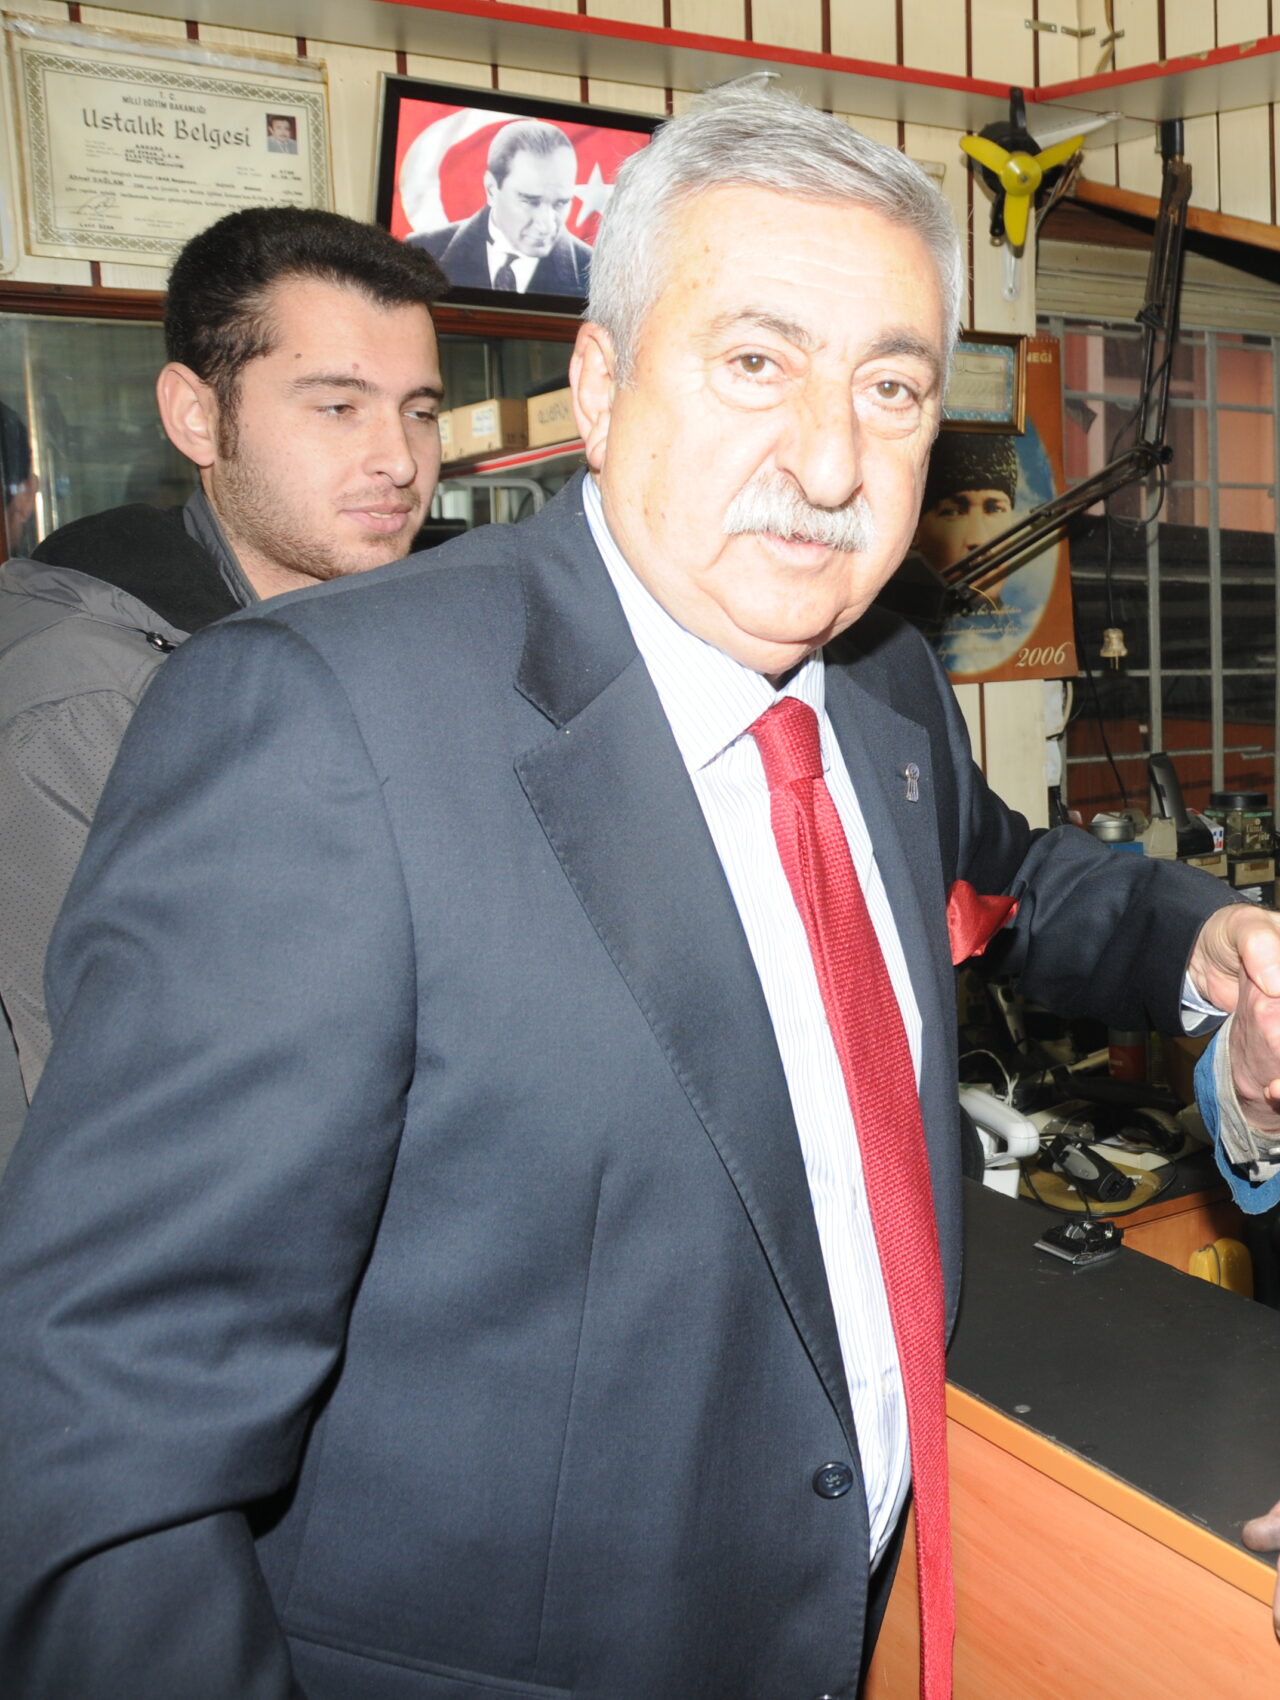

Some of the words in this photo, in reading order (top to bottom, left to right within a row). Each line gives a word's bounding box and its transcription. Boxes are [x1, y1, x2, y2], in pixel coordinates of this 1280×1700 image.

[82, 107, 165, 138] Ustalık
[174, 117, 251, 150] Belgesi
[1015, 641, 1072, 668] 2006
